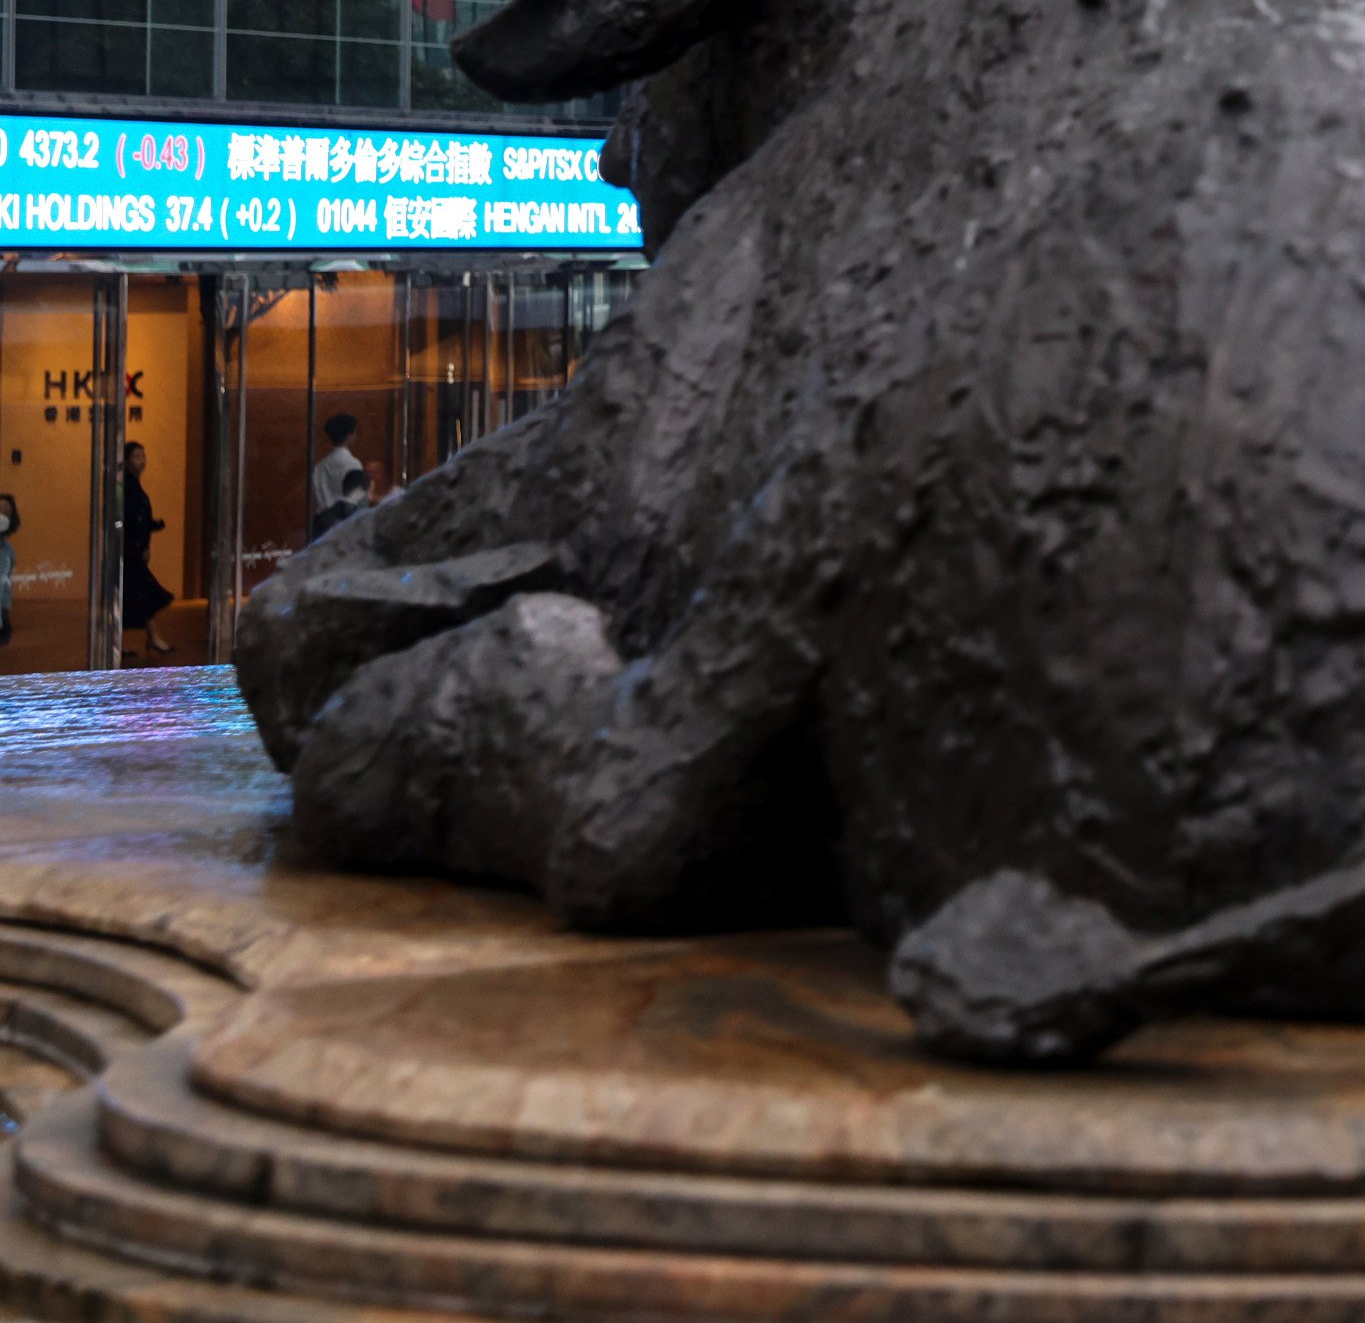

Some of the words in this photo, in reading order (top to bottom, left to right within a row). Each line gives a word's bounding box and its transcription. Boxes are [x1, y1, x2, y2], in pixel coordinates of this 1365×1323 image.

[19, 128, 100, 169] 4373.2
[503, 146, 583, 181] S&P/TSX
[26, 193, 155, 233] HOLDINGS
[166, 195, 213, 233] 37.4
[317, 197, 377, 233] 01044
[484, 201, 565, 234] HENGAN
